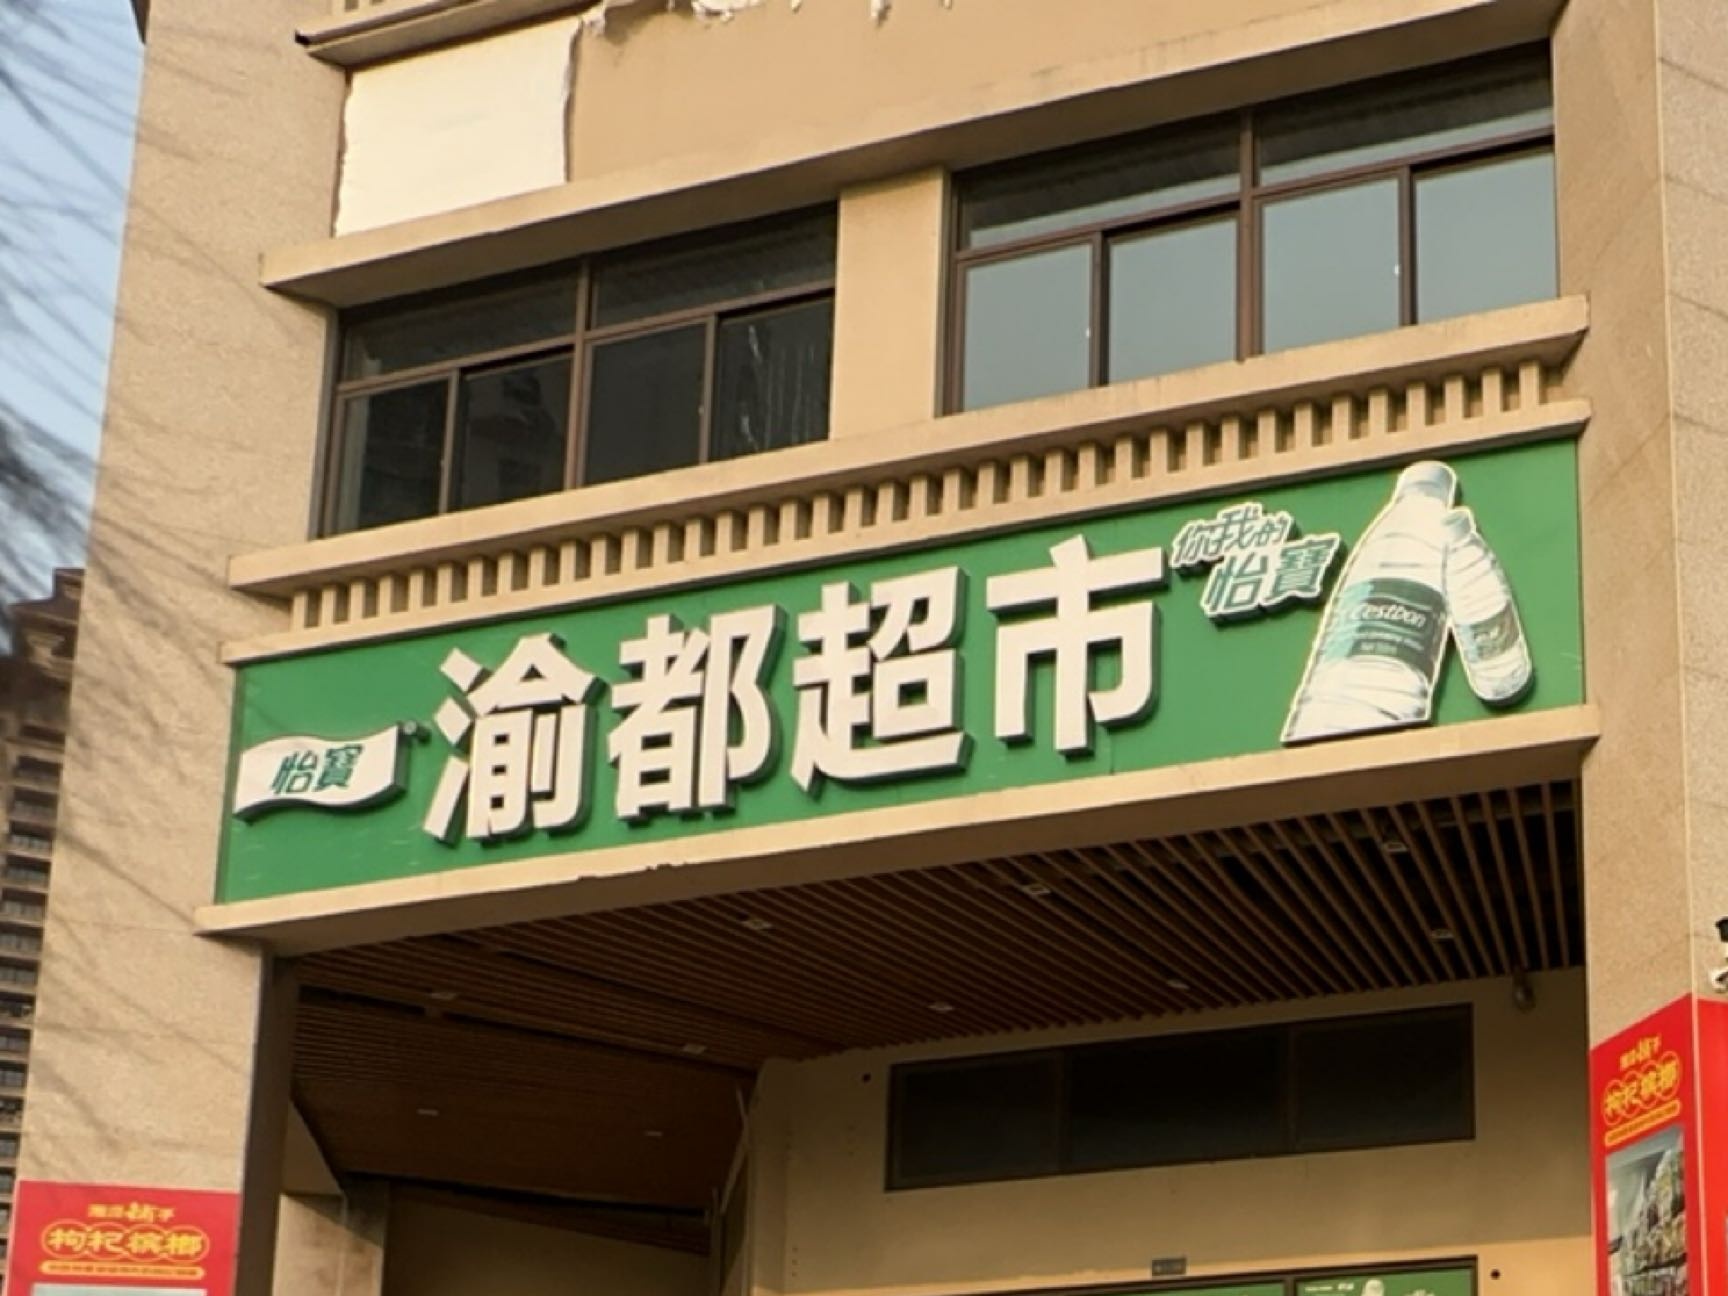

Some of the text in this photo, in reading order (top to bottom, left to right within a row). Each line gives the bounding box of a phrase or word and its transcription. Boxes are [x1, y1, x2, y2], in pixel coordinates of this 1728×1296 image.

[424, 534, 1166, 842] 渝都超市
[48, 1225, 203, 1256] 枸杞槟榔
